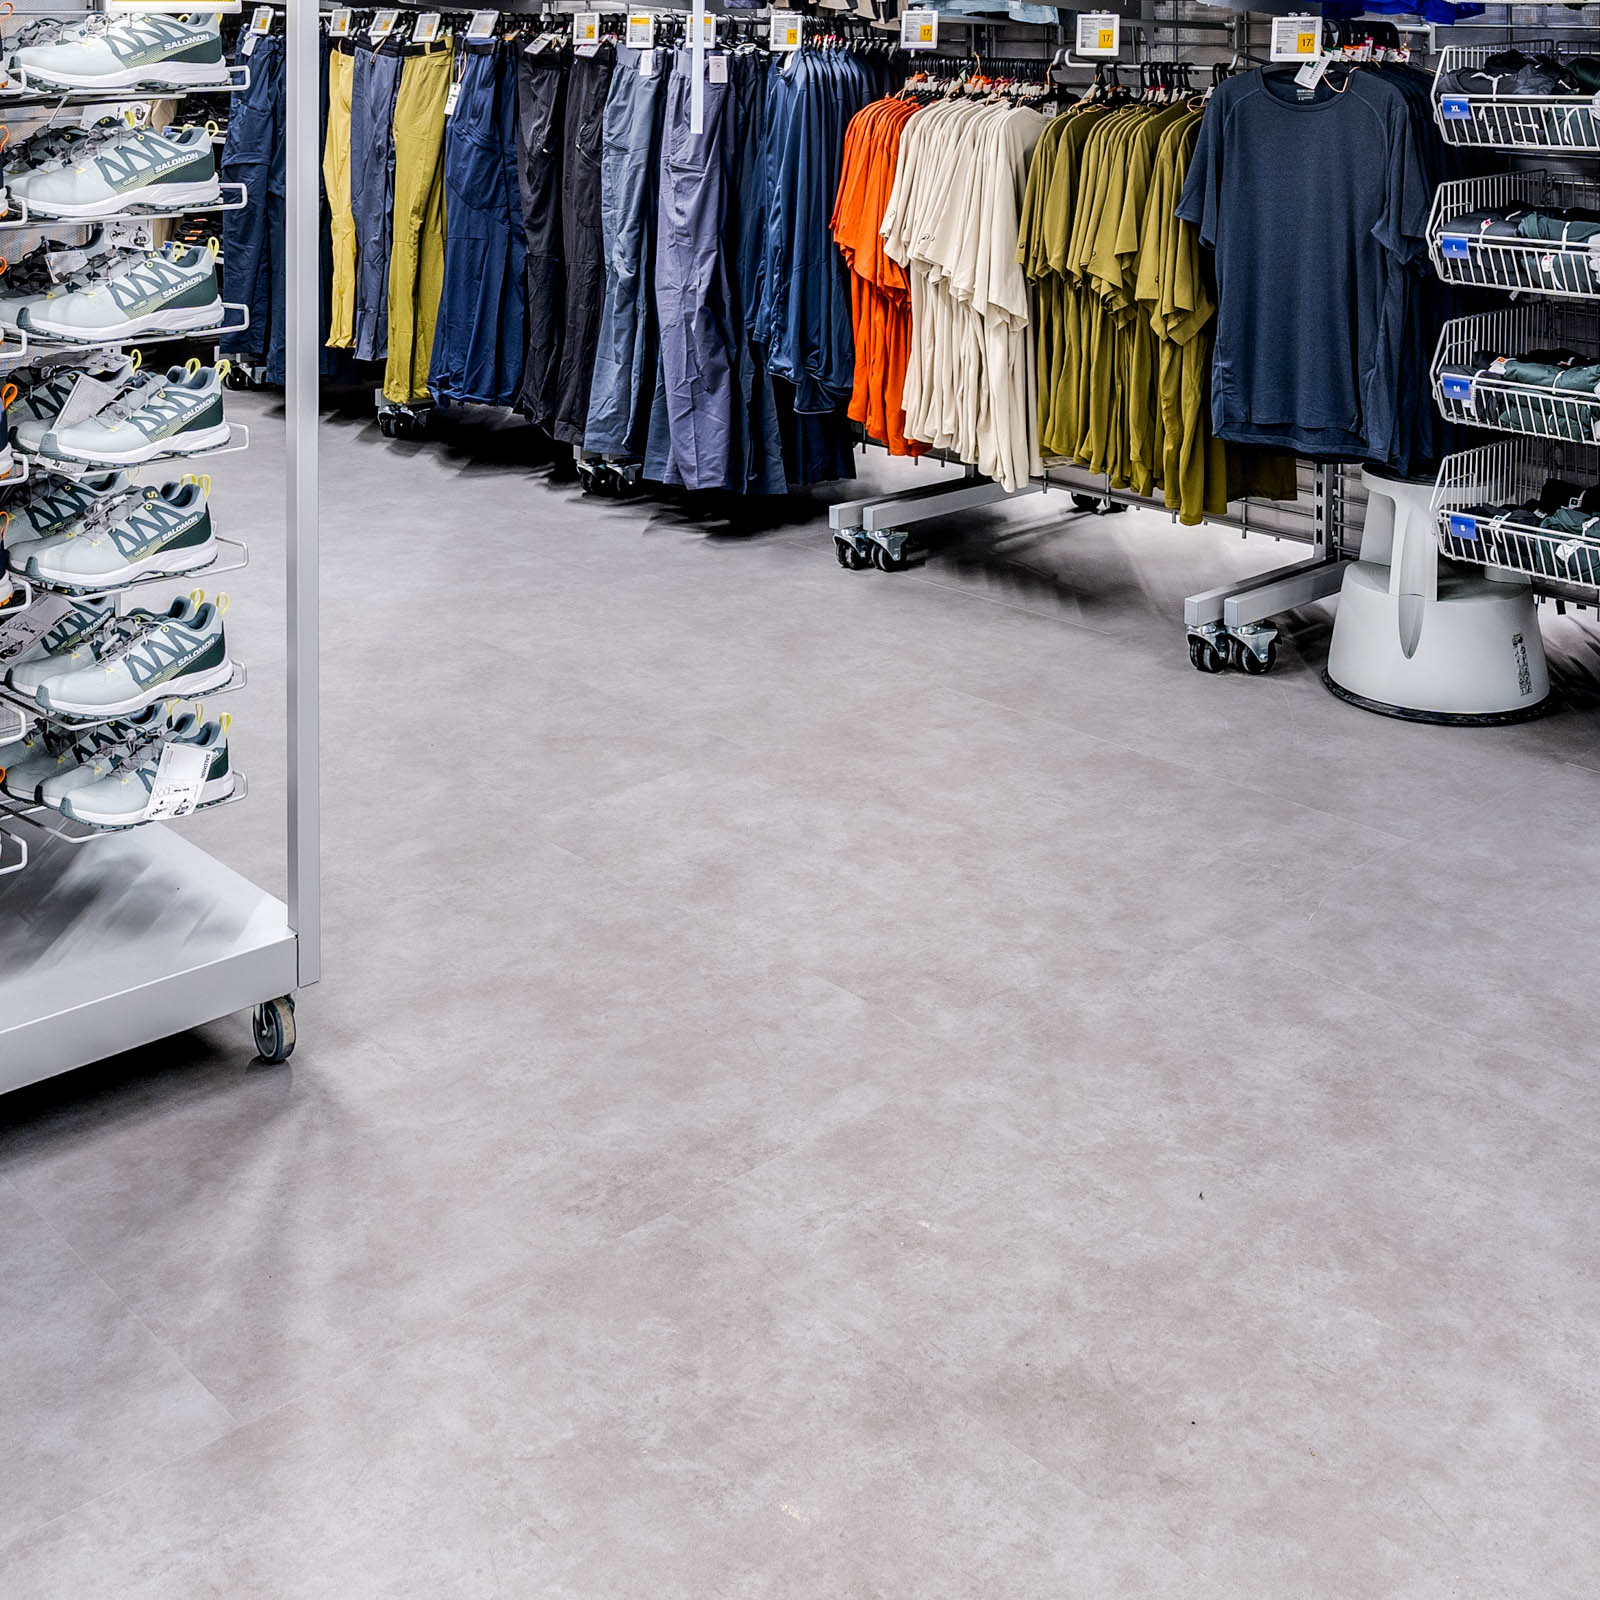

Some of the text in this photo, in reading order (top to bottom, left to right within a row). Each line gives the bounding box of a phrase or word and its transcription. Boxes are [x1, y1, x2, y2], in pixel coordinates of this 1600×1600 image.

[164, 33, 210, 52] SALOMON
[155, 152, 198, 175] SALOMON
[162, 274, 202, 299] SALOMON
[181, 395, 215, 422] SALOMON
[161, 515, 199, 542] SALOMON
[178, 638, 215, 667] SALOMON
